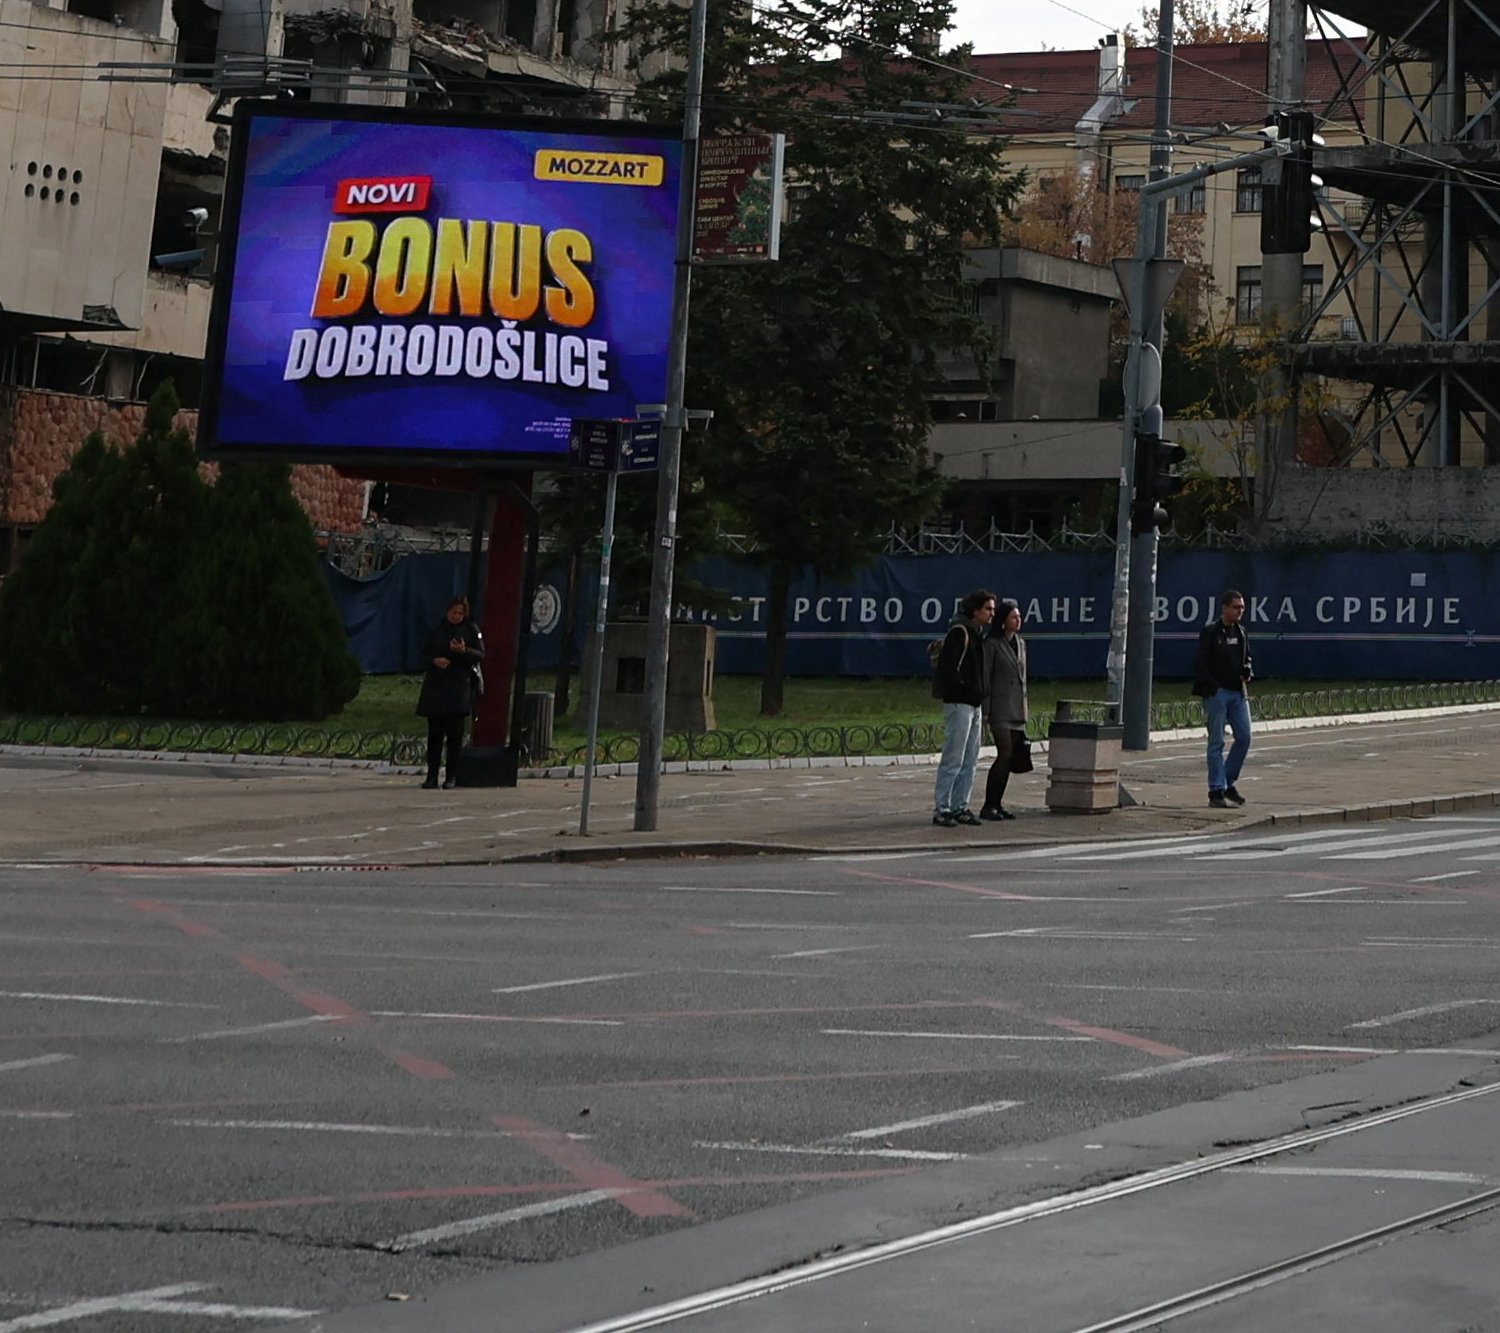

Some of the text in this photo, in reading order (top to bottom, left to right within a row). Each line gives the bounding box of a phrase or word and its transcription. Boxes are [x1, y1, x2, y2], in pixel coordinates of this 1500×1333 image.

[548, 157, 649, 180] MOZZART
[346, 183, 416, 206] NOVI
[310, 217, 595, 328] BONUS
[283, 320, 609, 391] DOBRODOŠLICE
[1154, 596, 1297, 625] ВОЈКА
[1316, 596, 1461, 628] СРБИЈЕ
